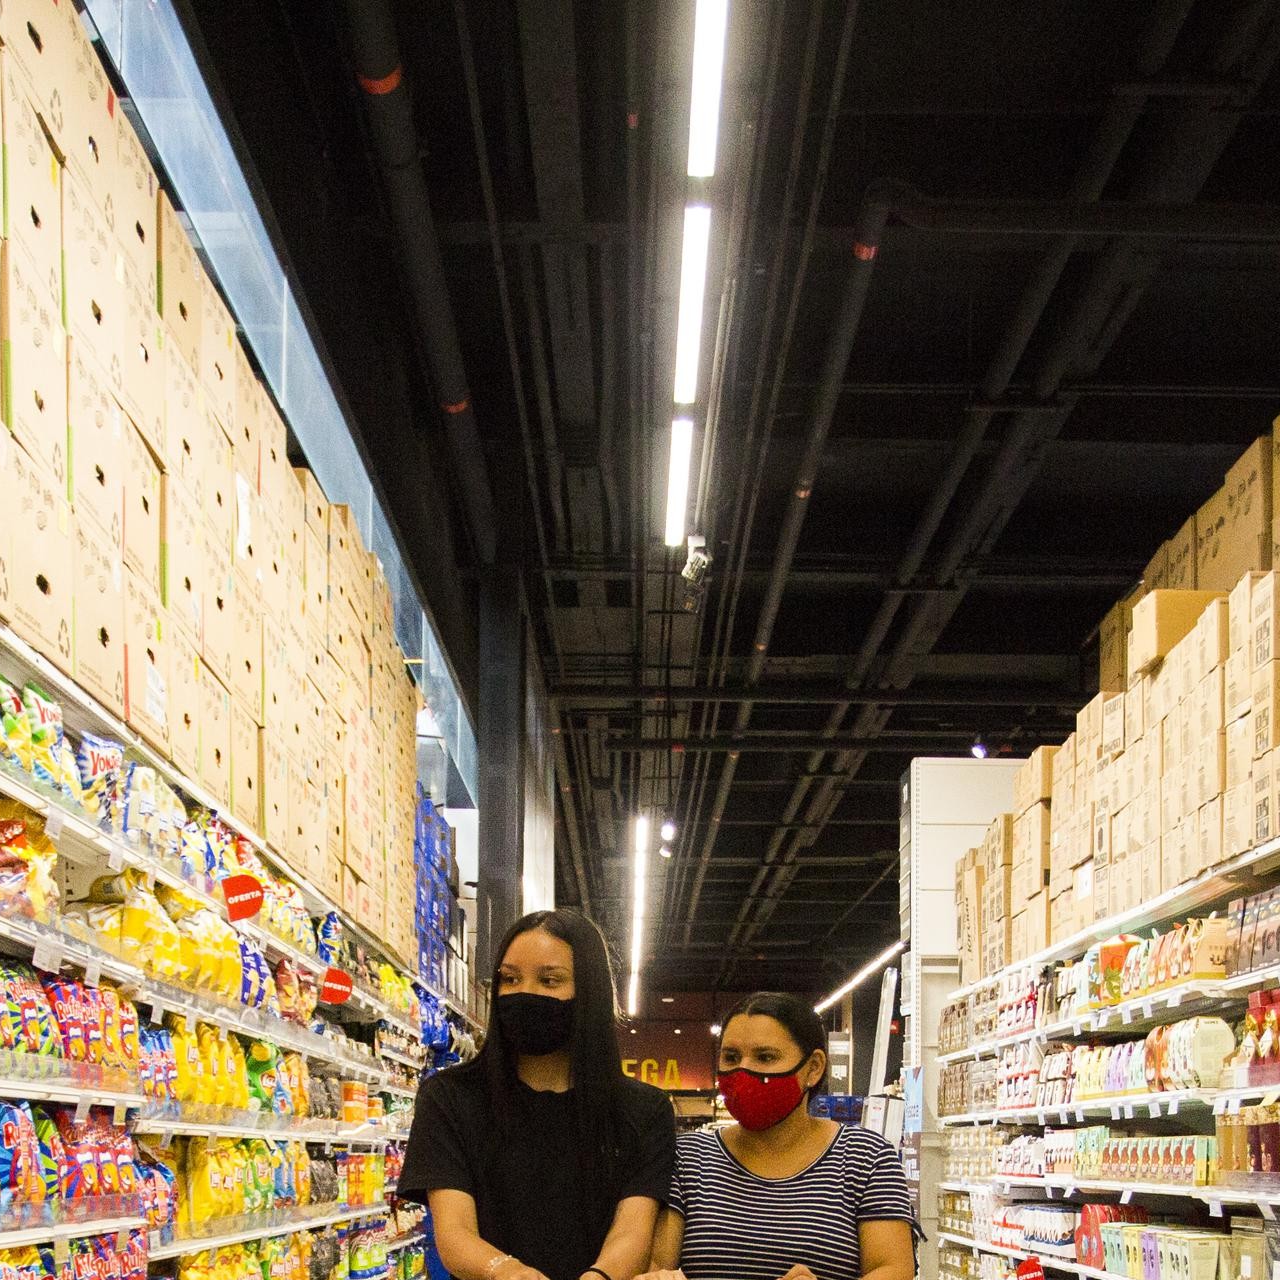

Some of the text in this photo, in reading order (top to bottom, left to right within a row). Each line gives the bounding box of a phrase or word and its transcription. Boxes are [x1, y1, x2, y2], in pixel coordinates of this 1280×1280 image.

[227, 890, 262, 905] OFERTA
[324, 981, 351, 993] OFERTA
[622, 1059, 681, 1089] EGA
